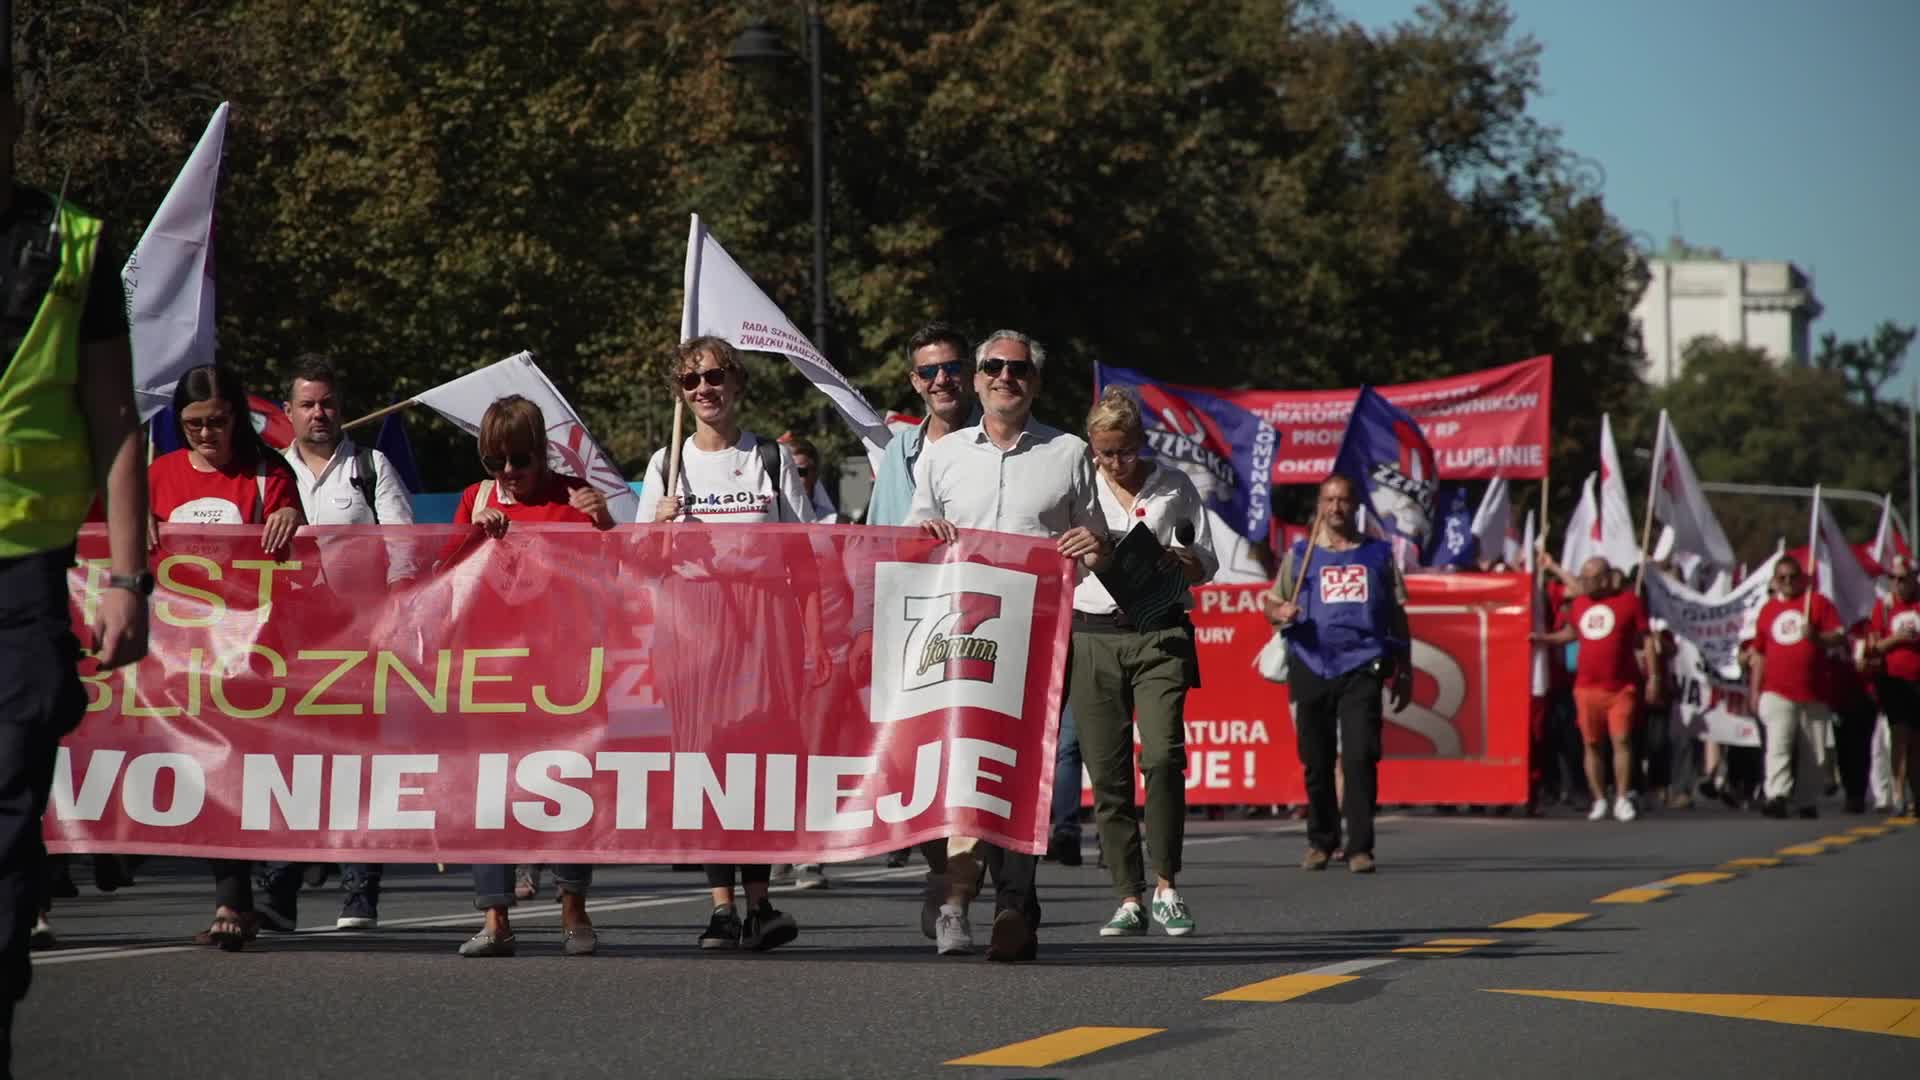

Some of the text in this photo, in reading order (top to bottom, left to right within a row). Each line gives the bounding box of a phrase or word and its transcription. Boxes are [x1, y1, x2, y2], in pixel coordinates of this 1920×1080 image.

[742, 321, 768, 335] RADA
[740, 334, 783, 349] ZWIĄZKU
[1445, 444, 1543, 468] LUBLINIE
[916, 632, 998, 675] forum
[240, 753, 439, 831] NIE
[474, 737, 1018, 832] ISTNIEJE
